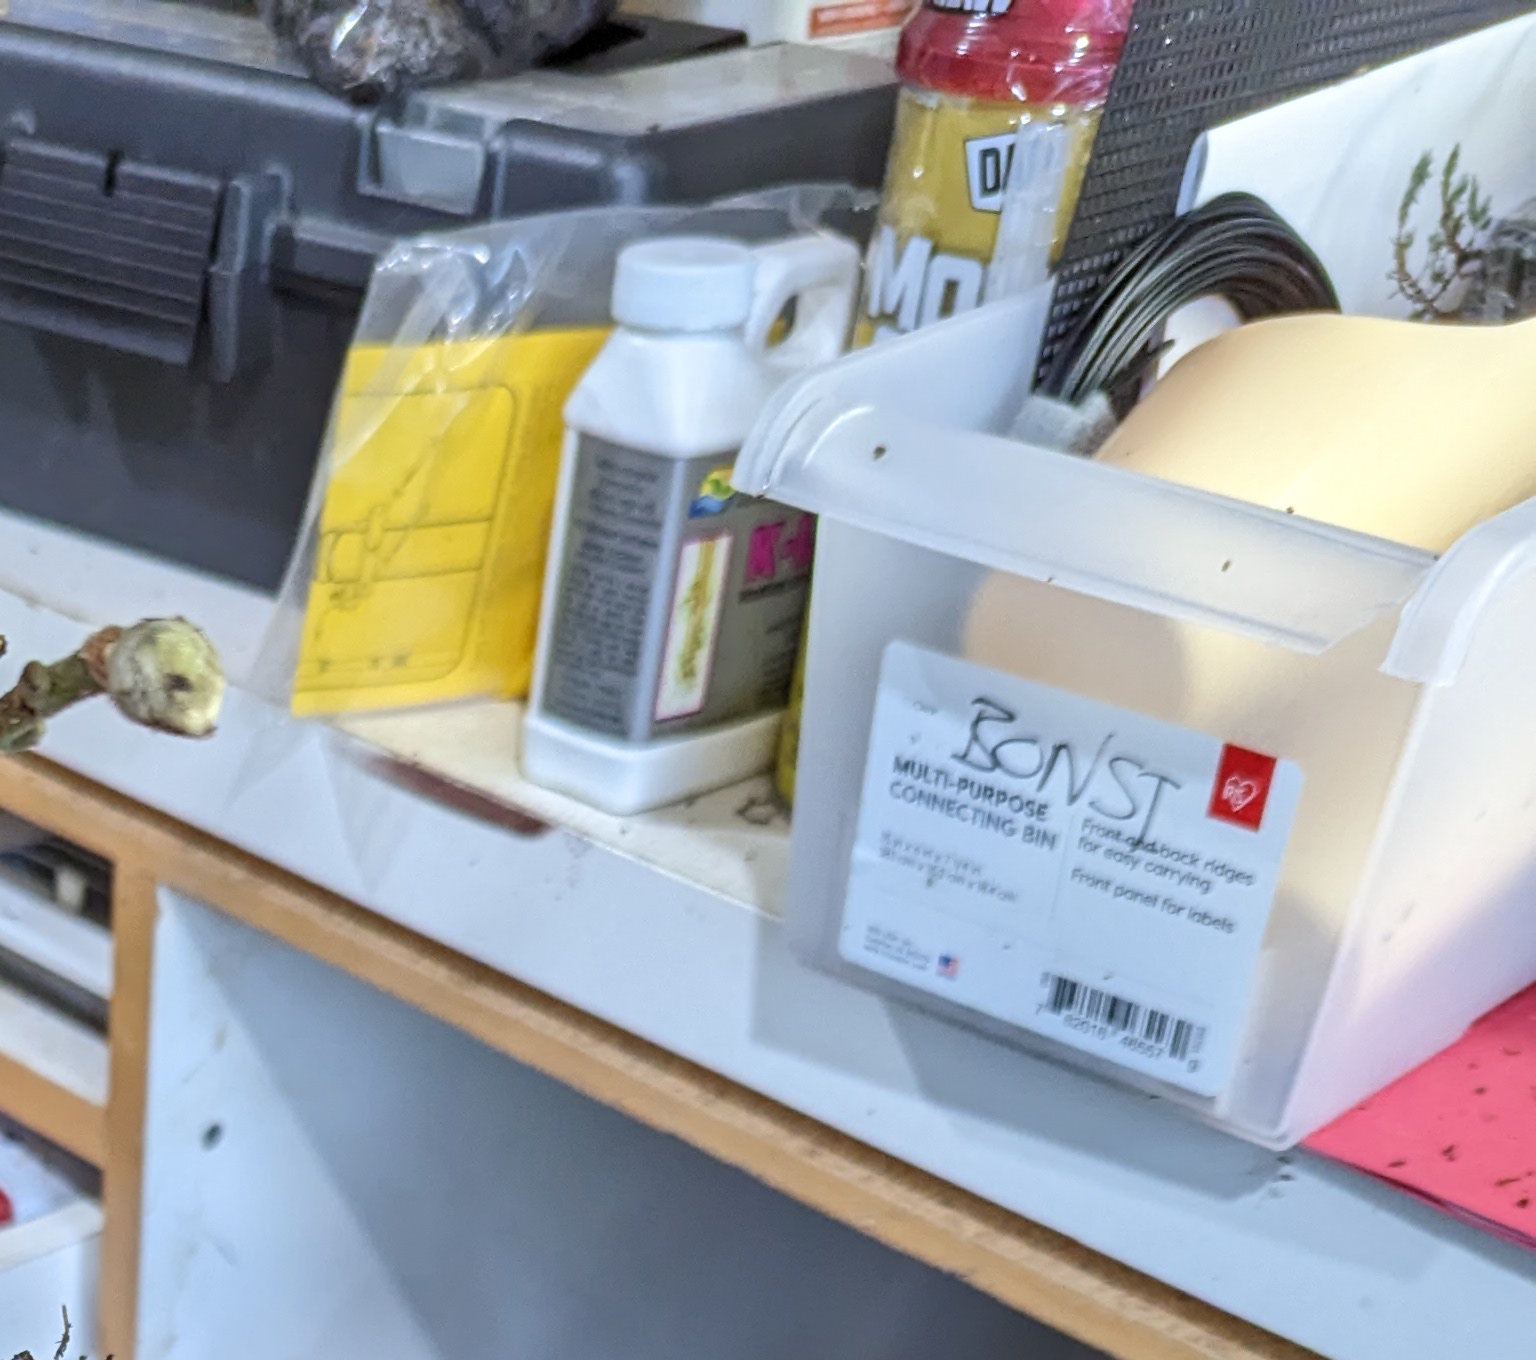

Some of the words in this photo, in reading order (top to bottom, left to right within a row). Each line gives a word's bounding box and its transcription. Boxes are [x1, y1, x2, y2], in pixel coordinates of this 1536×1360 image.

[888, 780, 1018, 838] CONNECTING
[1021, 823, 1058, 851] BIN
[892, 755, 1050, 822] MULTI-PURPOSE
[1078, 836, 1101, 854] for
[1102, 848, 1140, 871] easy
[1143, 860, 1213, 895] carrying
[1081, 818, 1121, 840] Front
[1159, 844, 1201, 867] back
[1203, 859, 1256, 887] ridges
[1070, 868, 1112, 893] Front
[1113, 884, 1159, 909] panel
[1160, 898, 1186, 916] for
[1187, 906, 1236, 934] labels
